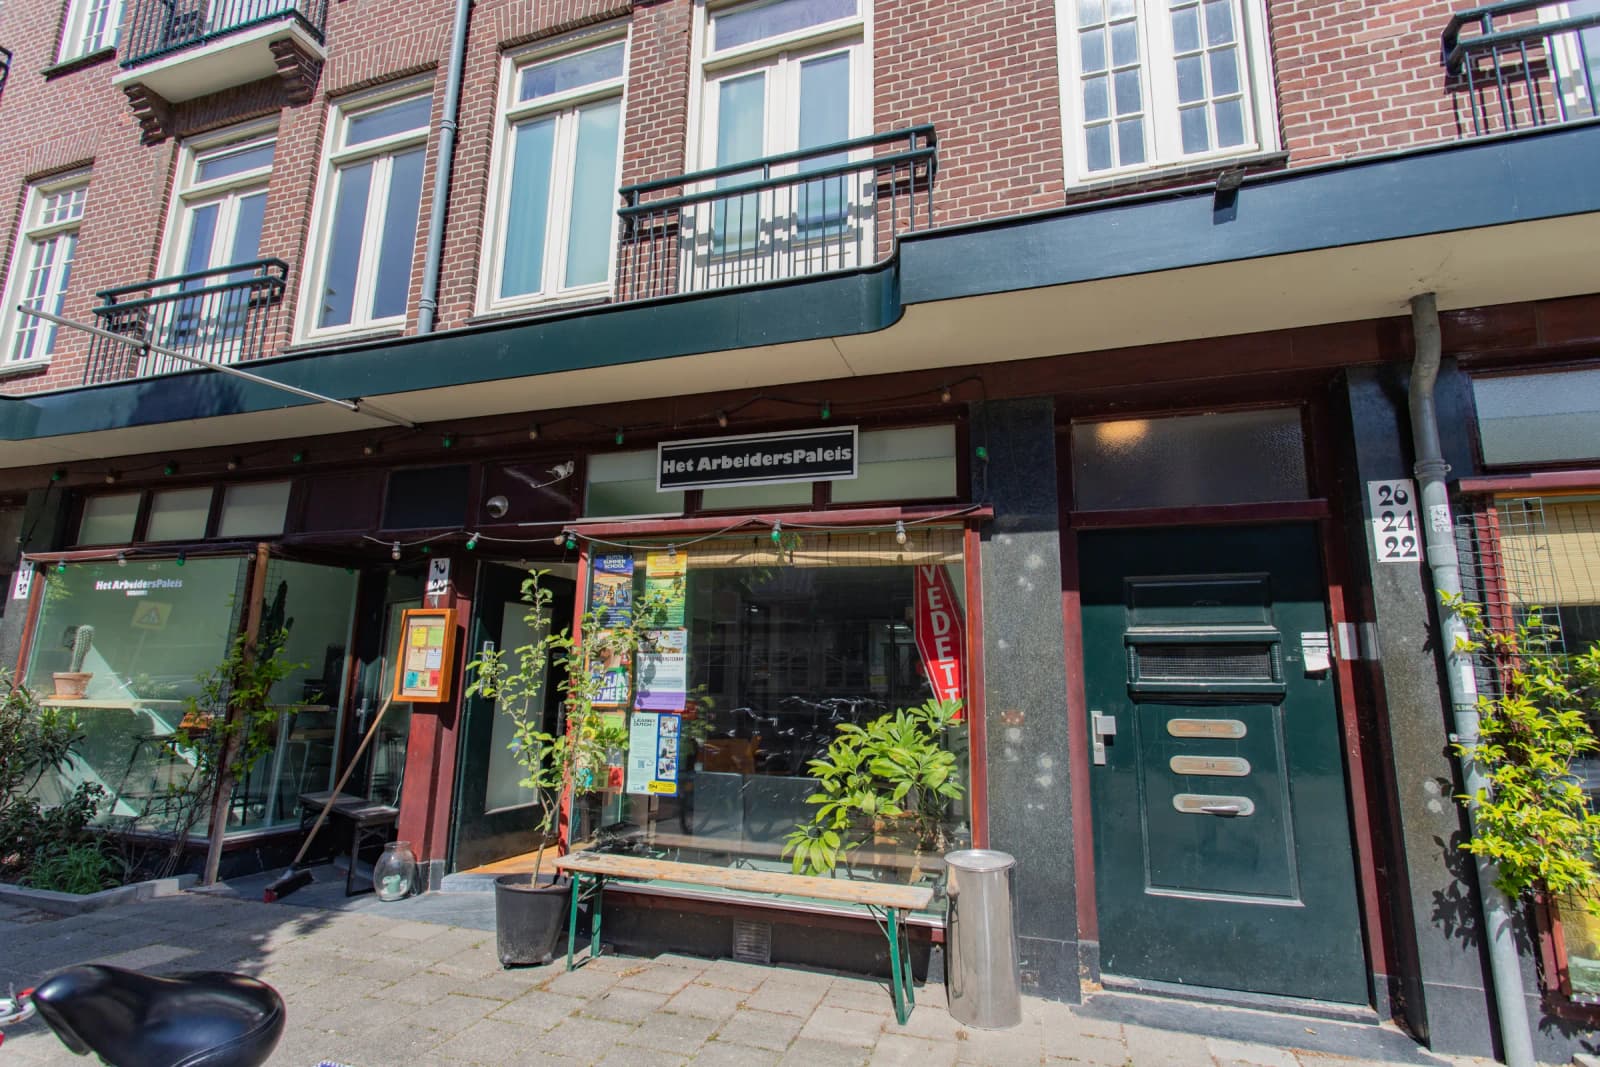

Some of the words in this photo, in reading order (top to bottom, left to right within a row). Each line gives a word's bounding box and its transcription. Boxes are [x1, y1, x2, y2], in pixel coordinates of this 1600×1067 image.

[662, 458, 695, 474] Het
[696, 446, 852, 471] ArbeidersPaleis
[1378, 484, 1409, 506] 26
[1381, 510, 1414, 532] 24
[1385, 535, 1417, 558] 22
[96, 581, 112, 591] Het
[113, 579, 183, 590] ArbeidersPaleis
